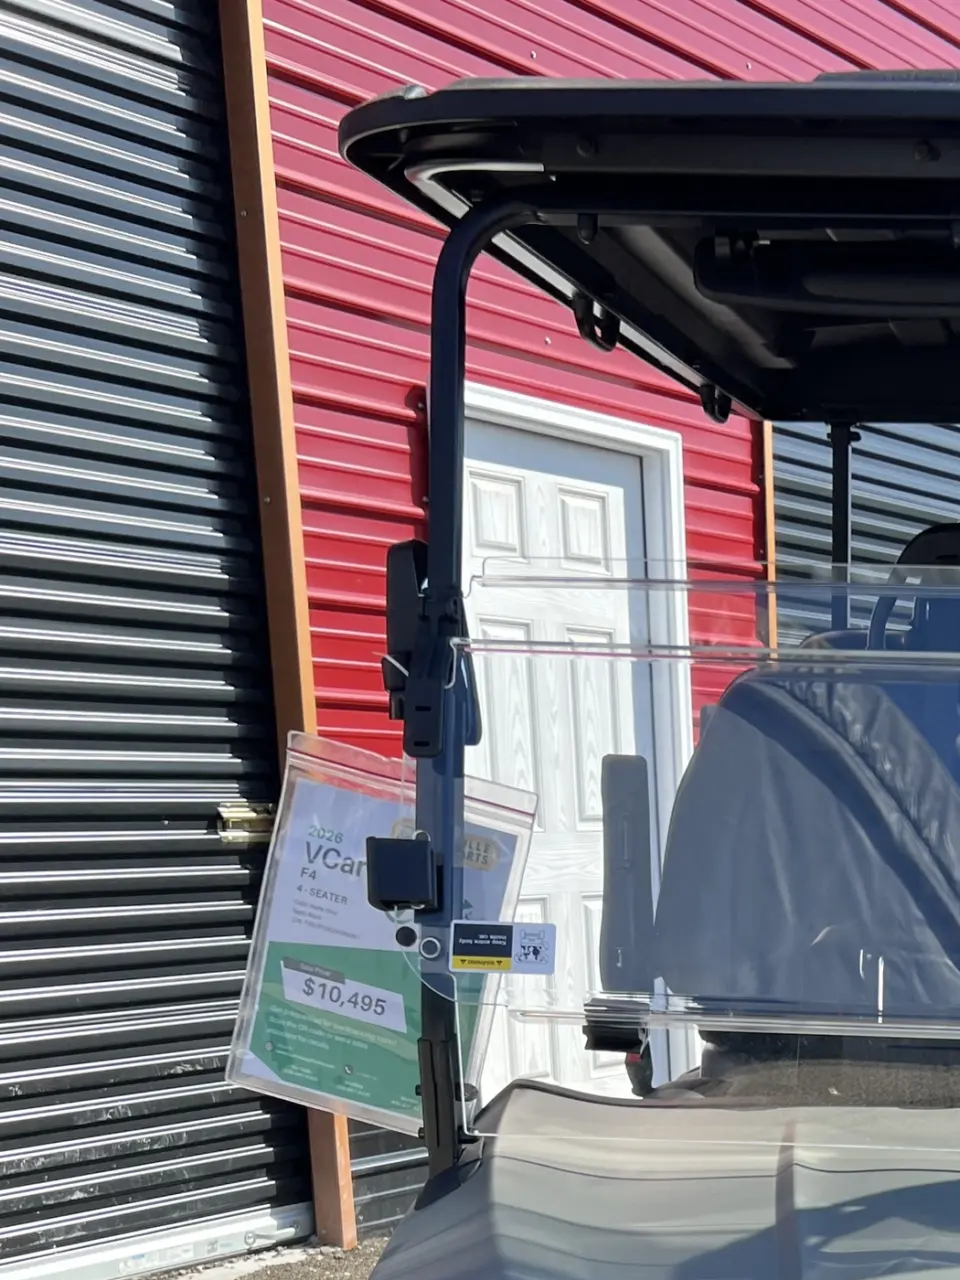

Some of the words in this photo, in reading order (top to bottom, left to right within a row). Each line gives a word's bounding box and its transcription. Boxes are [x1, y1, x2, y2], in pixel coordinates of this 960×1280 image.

[308, 825, 344, 844] 2026
[300, 867, 317, 880] F4
[296, 885, 303, 893] 4
[309, 887, 348, 905] SEATER
[302, 977, 387, 1016] $10,495
